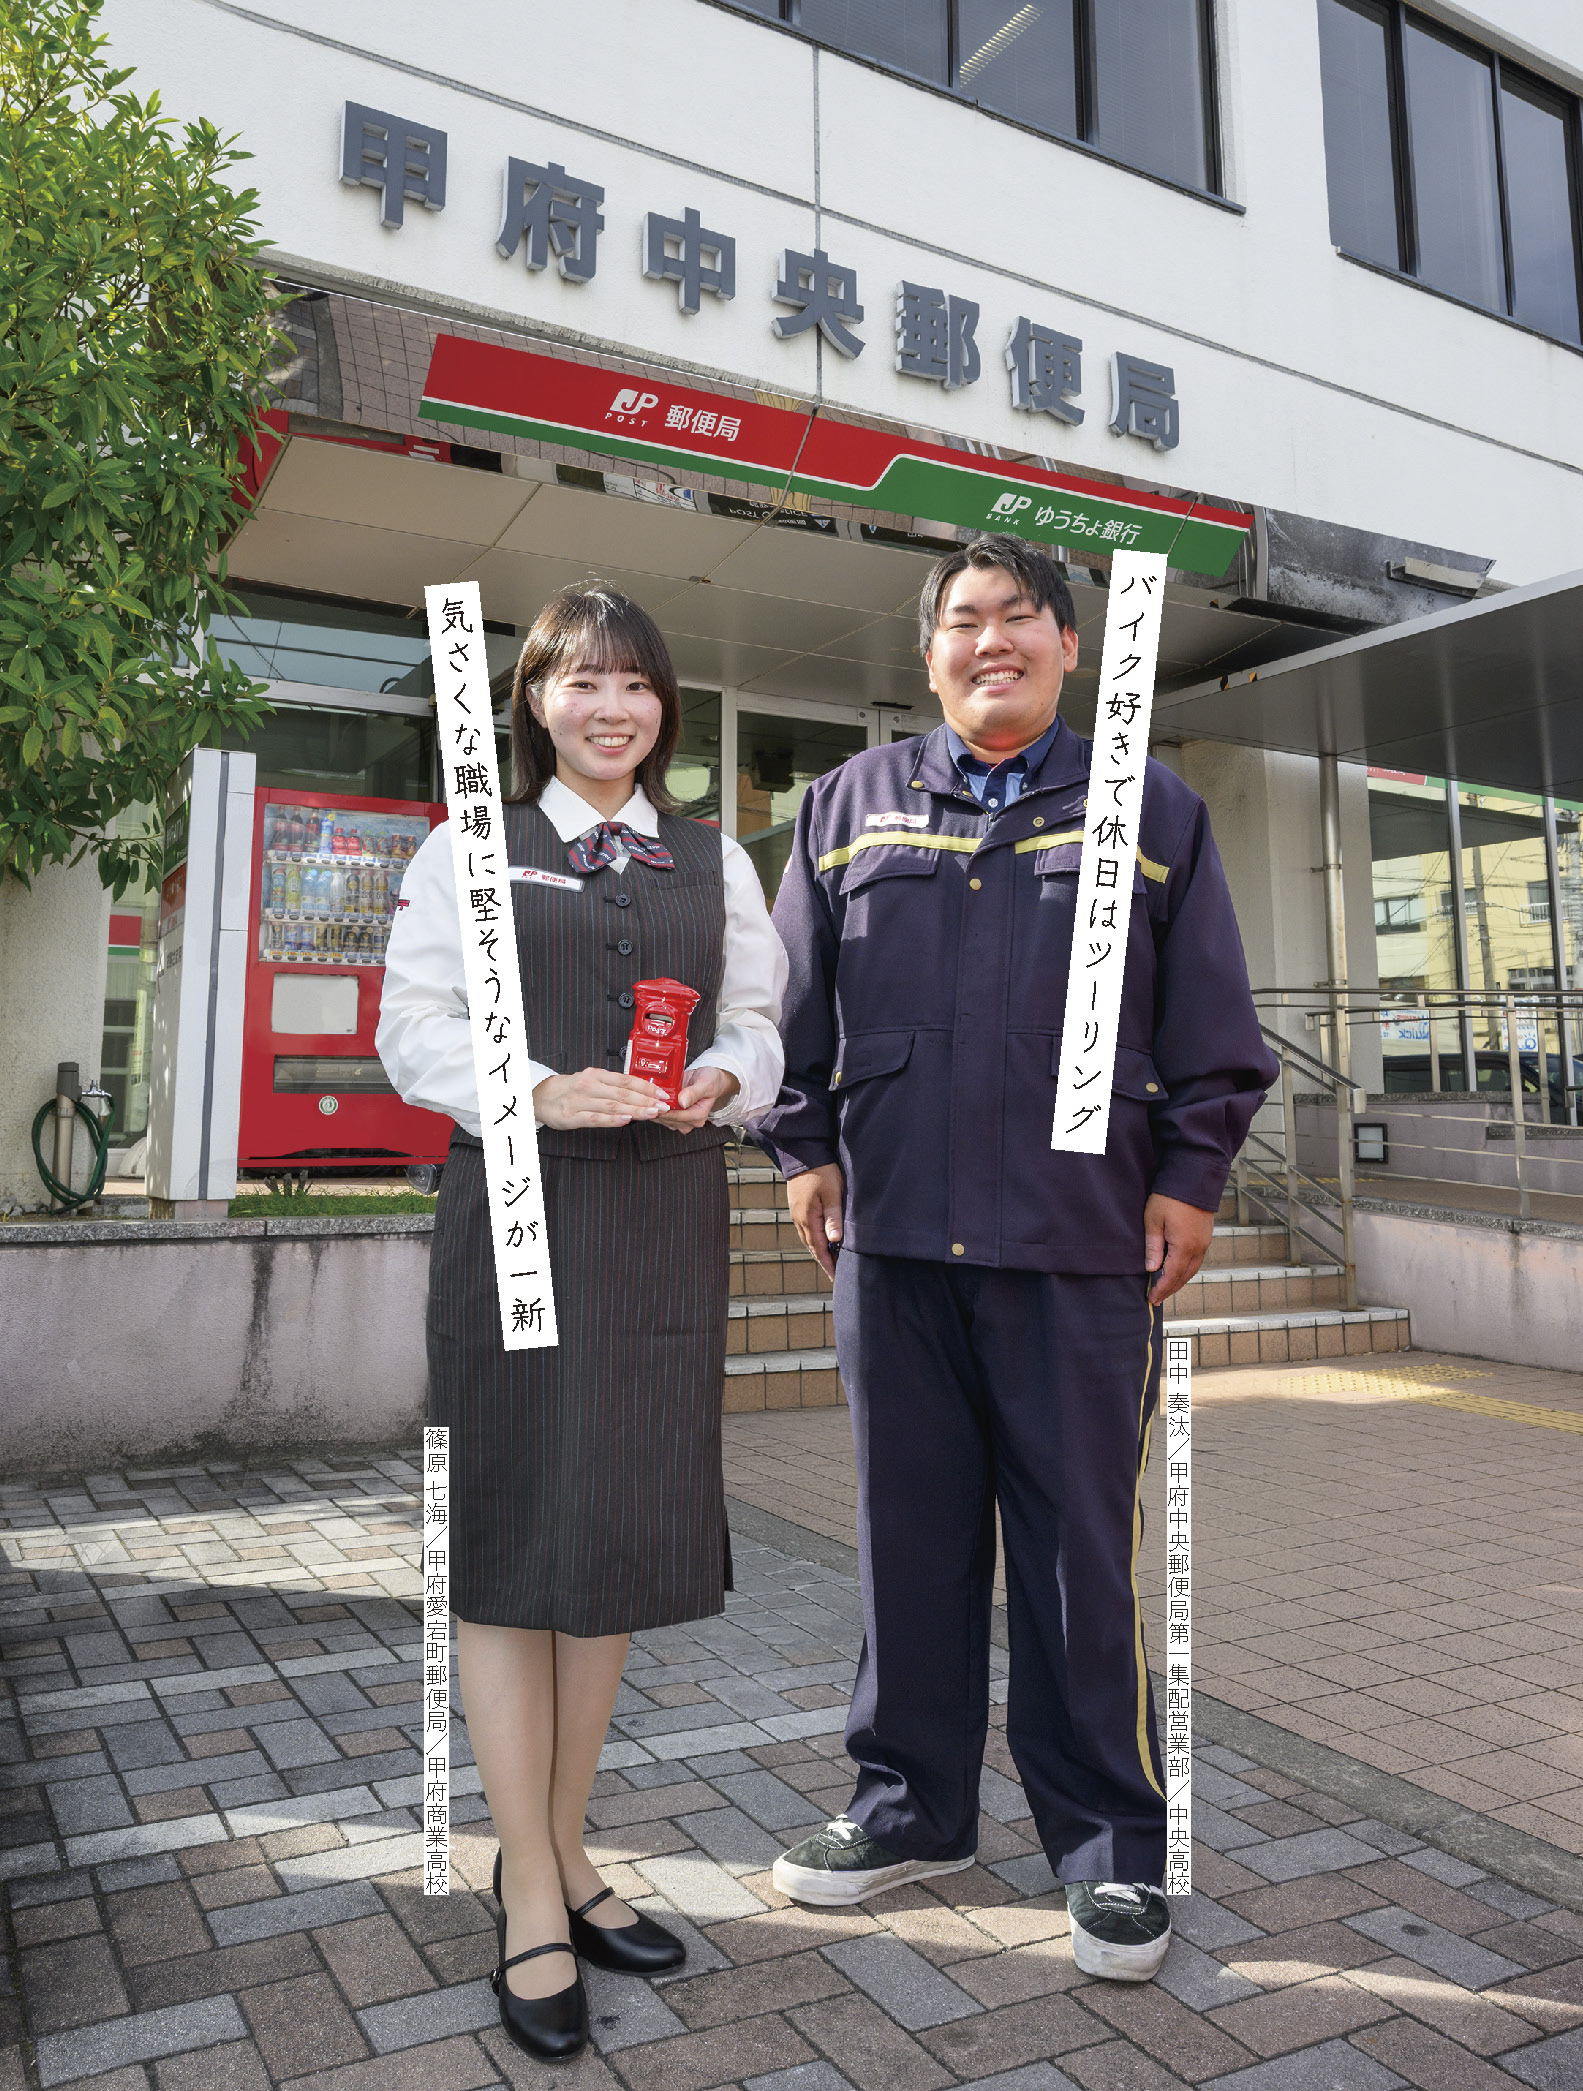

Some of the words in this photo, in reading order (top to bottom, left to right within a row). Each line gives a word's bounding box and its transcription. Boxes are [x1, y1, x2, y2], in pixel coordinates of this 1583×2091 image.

[339, 100, 1181, 452] 甲府中央郵便局
[610, 388, 659, 414] JP
[604, 412, 649, 427] POST
[664, 404, 742, 442] 郵便局
[991, 492, 1032, 515] JP
[985, 513, 1020, 526] BANK
[1034, 505, 1143, 545] ゆうちょ銀行
